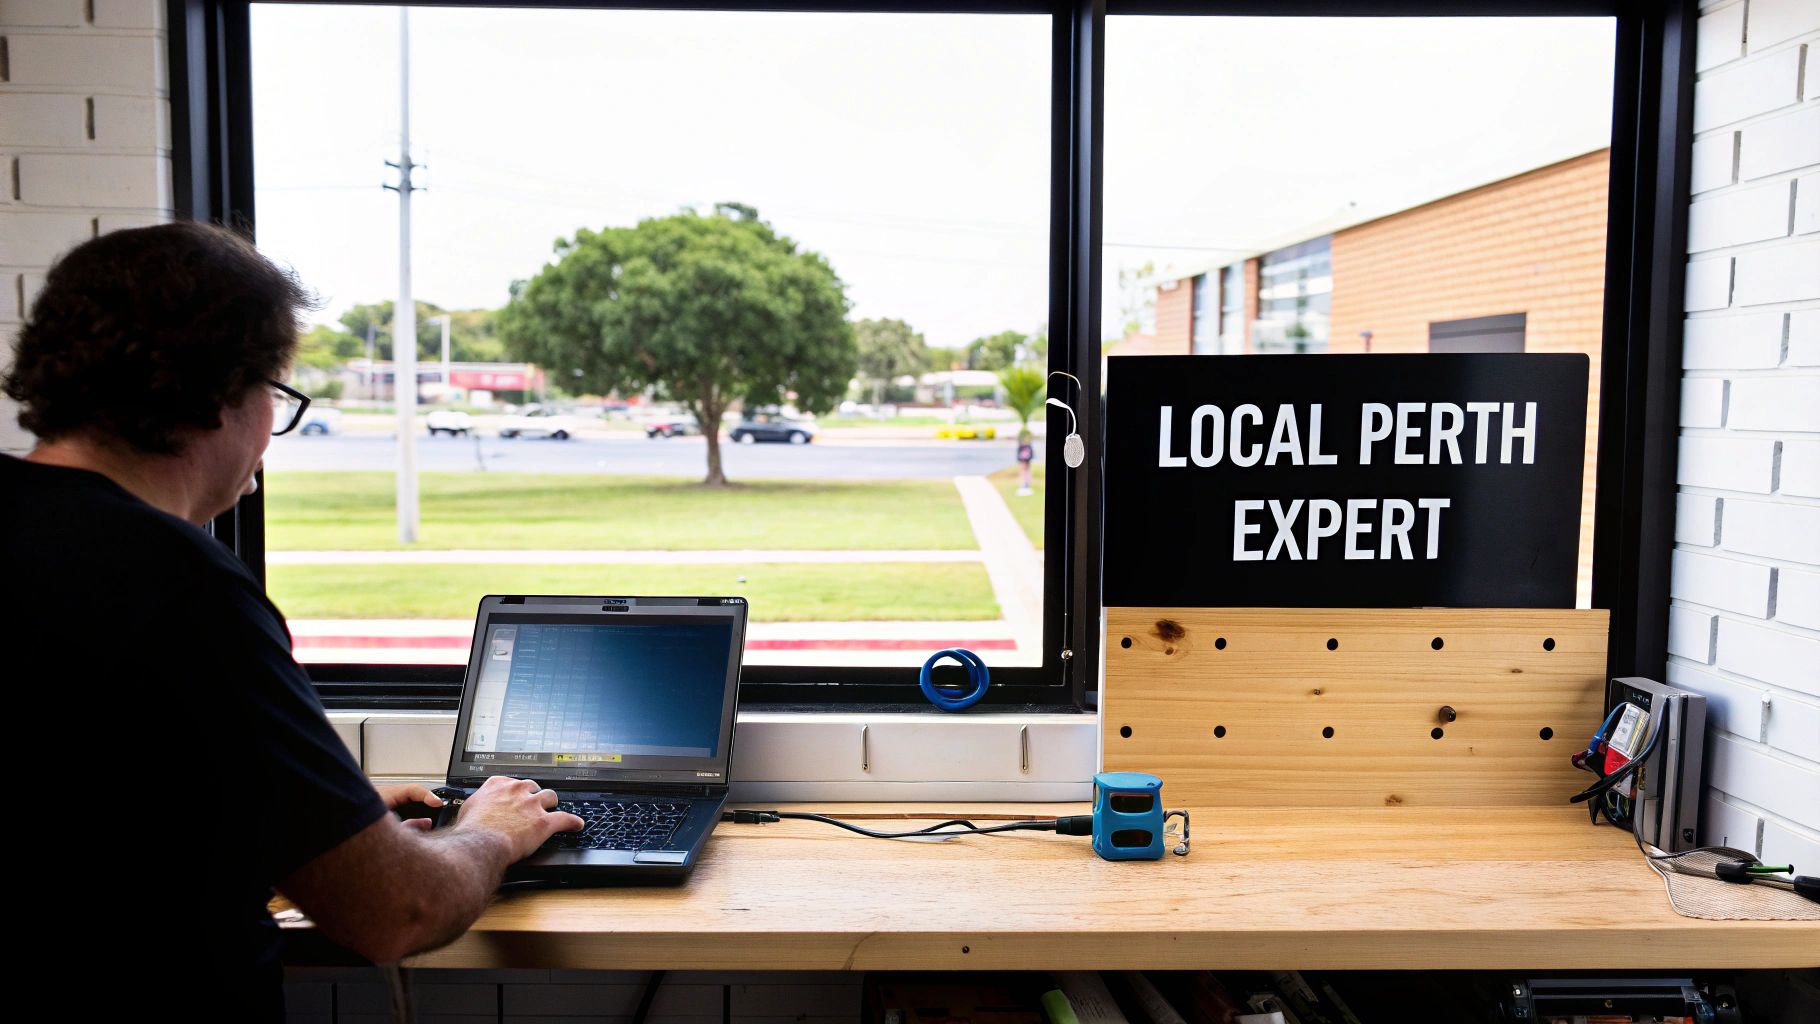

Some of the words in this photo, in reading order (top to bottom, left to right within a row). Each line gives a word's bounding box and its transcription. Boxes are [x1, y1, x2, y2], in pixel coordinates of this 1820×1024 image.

[1158, 403, 1338, 468] LOCAL
[1359, 401, 1538, 465] PERTH
[1232, 497, 1451, 562] EXPERT
